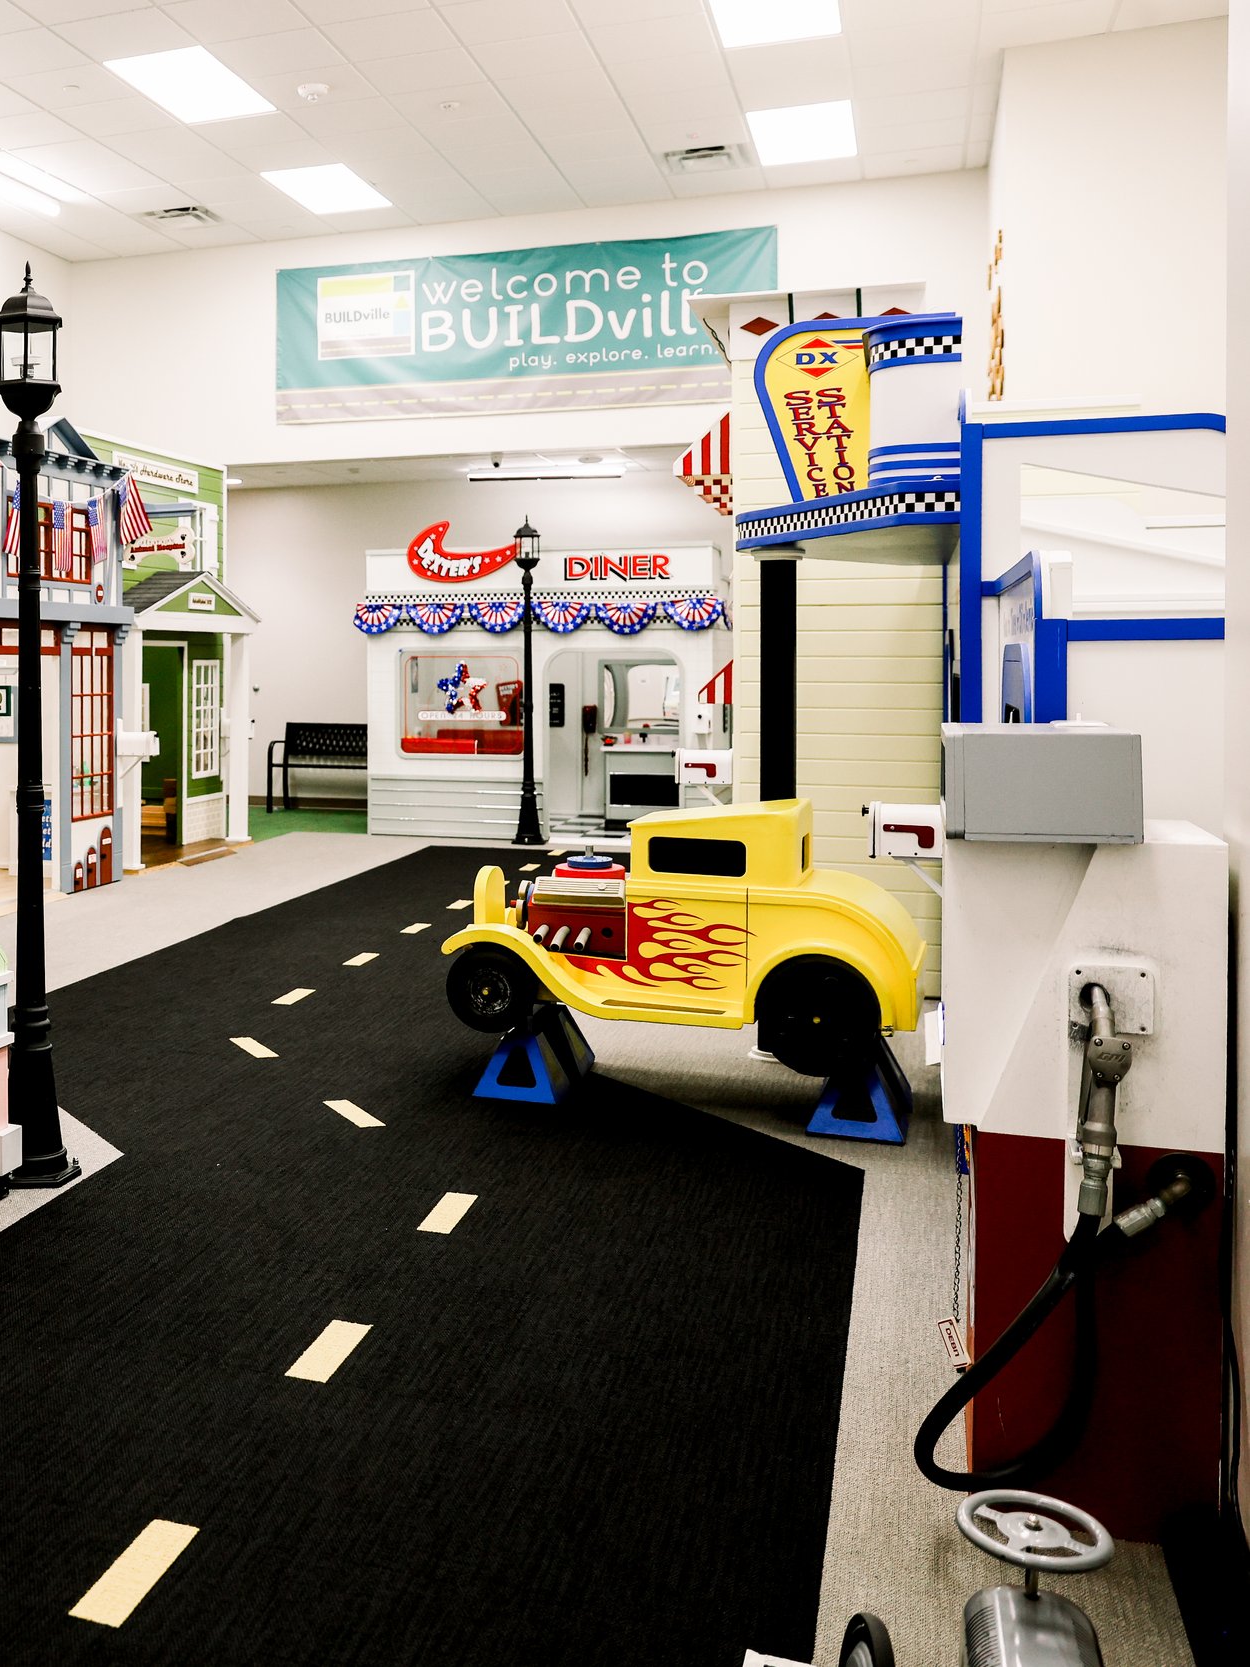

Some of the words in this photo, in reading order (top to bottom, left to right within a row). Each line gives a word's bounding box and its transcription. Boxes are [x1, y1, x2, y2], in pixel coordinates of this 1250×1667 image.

[421, 265, 642, 305] welcome
[661, 252, 709, 287] to
[324, 307, 390, 324] BUILDville
[420, 287, 704, 352] BUILDvill
[509, 352, 557, 371] play.
[565, 346, 648, 366] explore.
[795, 351, 839, 366] DX
[783, 390, 829, 499] SERVICE
[815, 387, 855, 494] STATION
[139, 464, 174, 483] Hardware
[175, 473, 194, 487] Store
[417, 536, 482, 577] DEXTER'S
[564, 553, 671, 582] DINER
